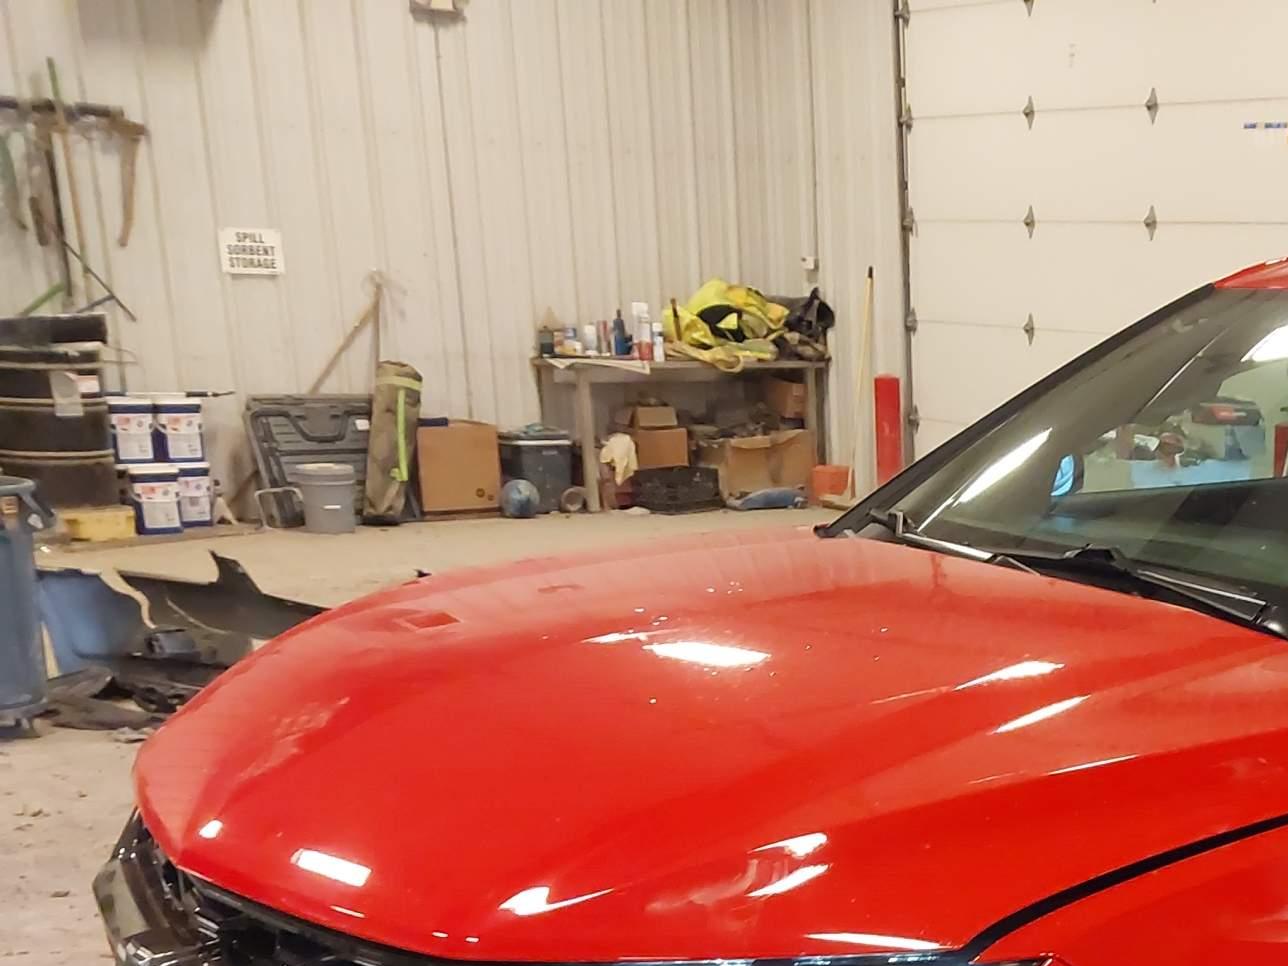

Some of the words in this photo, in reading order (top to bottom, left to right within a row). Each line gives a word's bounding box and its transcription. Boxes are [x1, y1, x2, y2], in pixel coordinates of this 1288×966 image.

[235, 231, 265, 244] SPILL
[226, 244, 276, 256] SORBENT
[228, 256, 278, 270] STORAGE
